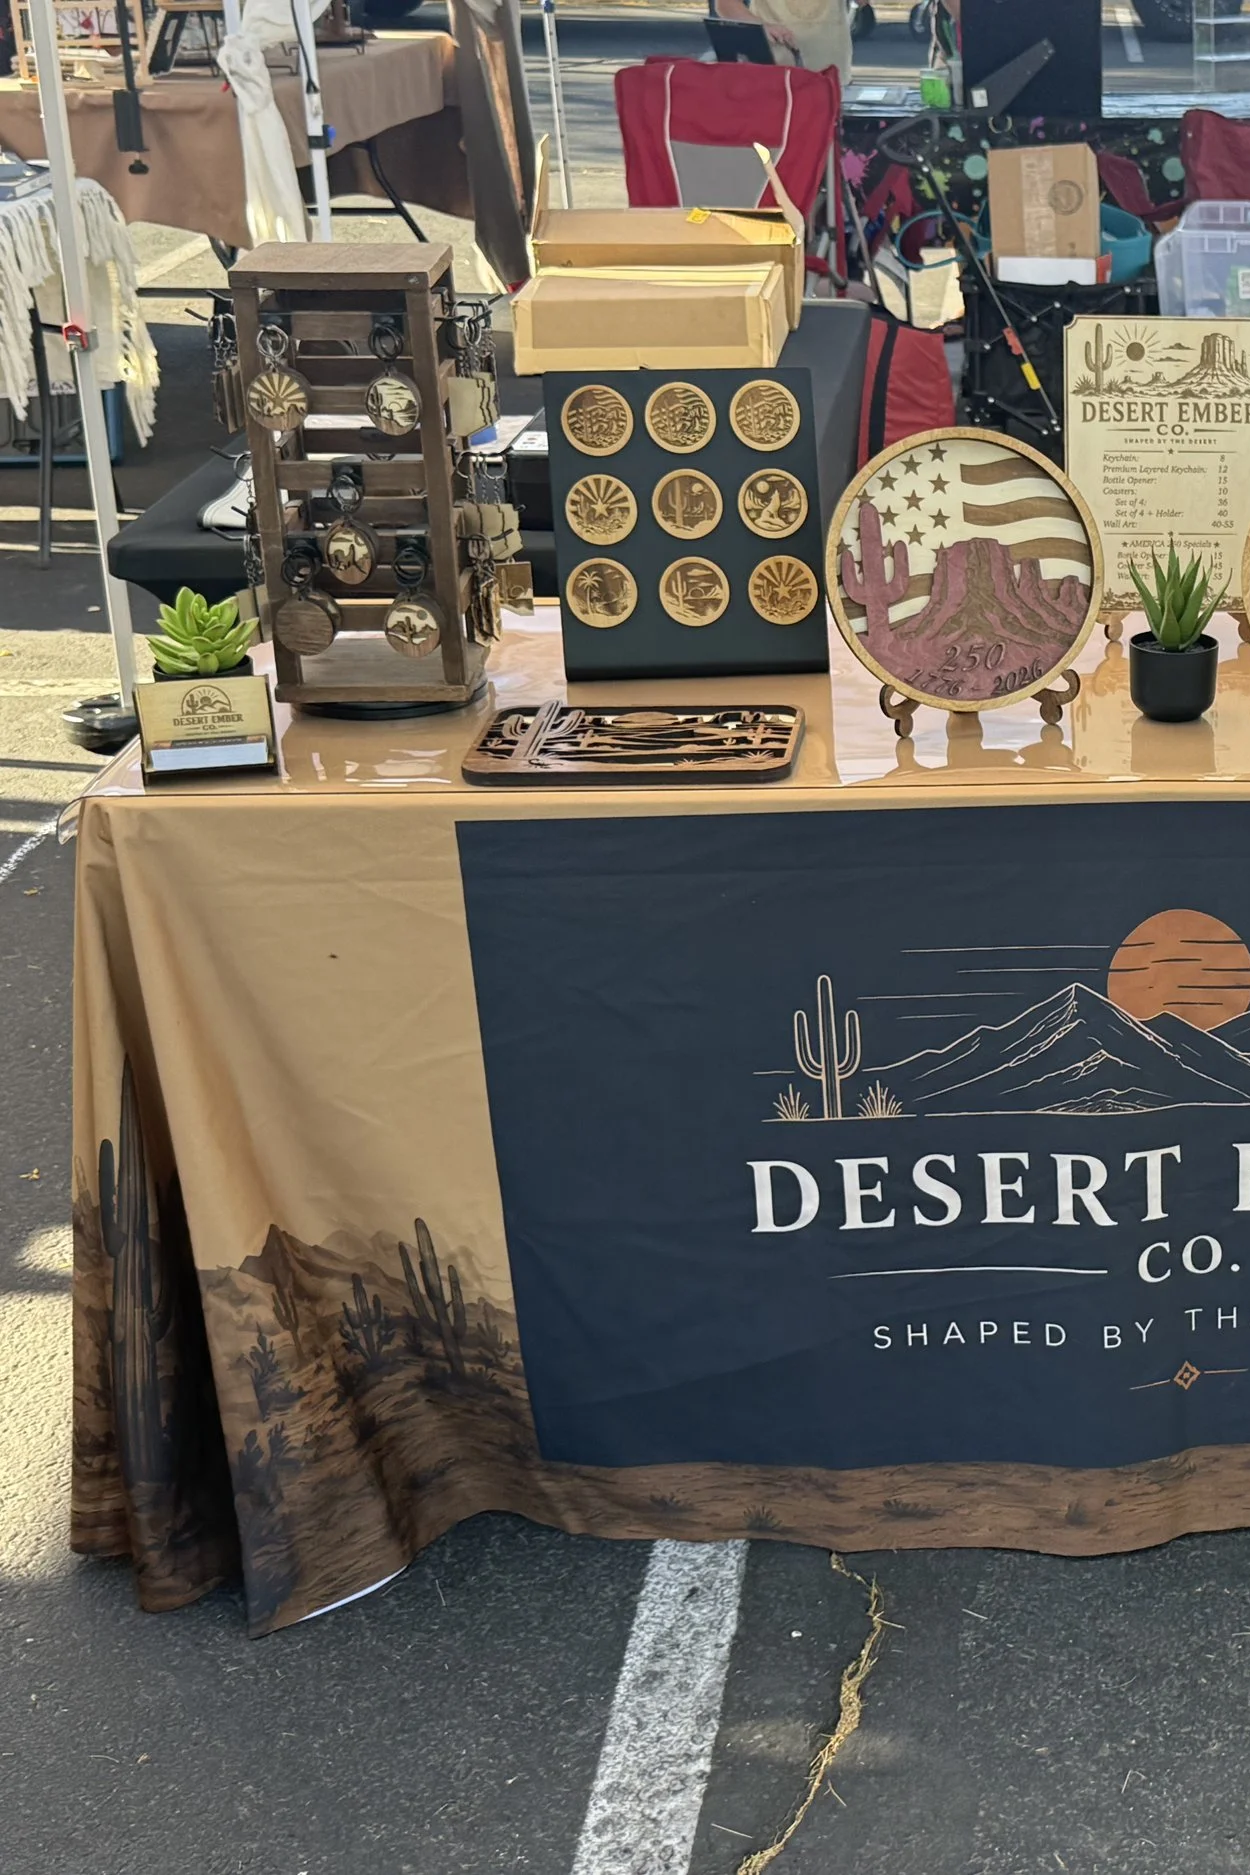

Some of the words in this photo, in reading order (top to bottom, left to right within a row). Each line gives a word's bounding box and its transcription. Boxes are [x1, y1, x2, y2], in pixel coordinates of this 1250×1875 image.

[1082, 401, 1169, 423] DESERT
[1156, 424, 1189, 436] CO.
[1103, 454, 1139, 463] Keychain:
[1103, 465, 1137, 473] Premium
[1140, 465, 1169, 474] Layered
[1171, 465, 1207, 475] Keychain:
[1218, 465, 1228, 473] 12
[1103, 476, 1125, 484] Bottle
[1127, 476, 1157, 486] Opener:
[1218, 476, 1228, 484] 15
[1103, 487, 1137, 495] Coasters:
[1218, 487, 1228, 495] 10
[1115, 498, 1127, 506] Set
[1129, 498, 1138, 508] of
[1139, 498, 1147, 506] 4:
[1217, 498, 1228, 506] 36
[1115, 509, 1127, 517] Set
[1129, 509, 1138, 519] of
[1139, 509, 1144, 517] 4
[1156, 509, 1184, 517] Holder:
[1217, 509, 1228, 517] 40
[1103, 519, 1120, 528] Wall
[1122, 520, 1138, 528] Art:
[1211, 520, 1234, 528] 40-55
[1129, 540, 1165, 548] AMERICA
[1183, 540, 1212, 549] Specials
[1213, 572, 1223, 580] 55
[939, 642, 1006, 672] 250
[904, 668, 965, 696] 1776
[991, 657, 1044, 695] 2026
[172, 715, 208, 727] DESERT
[211, 713, 244, 724] EMBER
[745, 1145, 1182, 1233] DESERT
[1137, 1234, 1240, 1284] CO.
[873, 1321, 1067, 1349] SHAPED
[1103, 1318, 1154, 1349] BY
